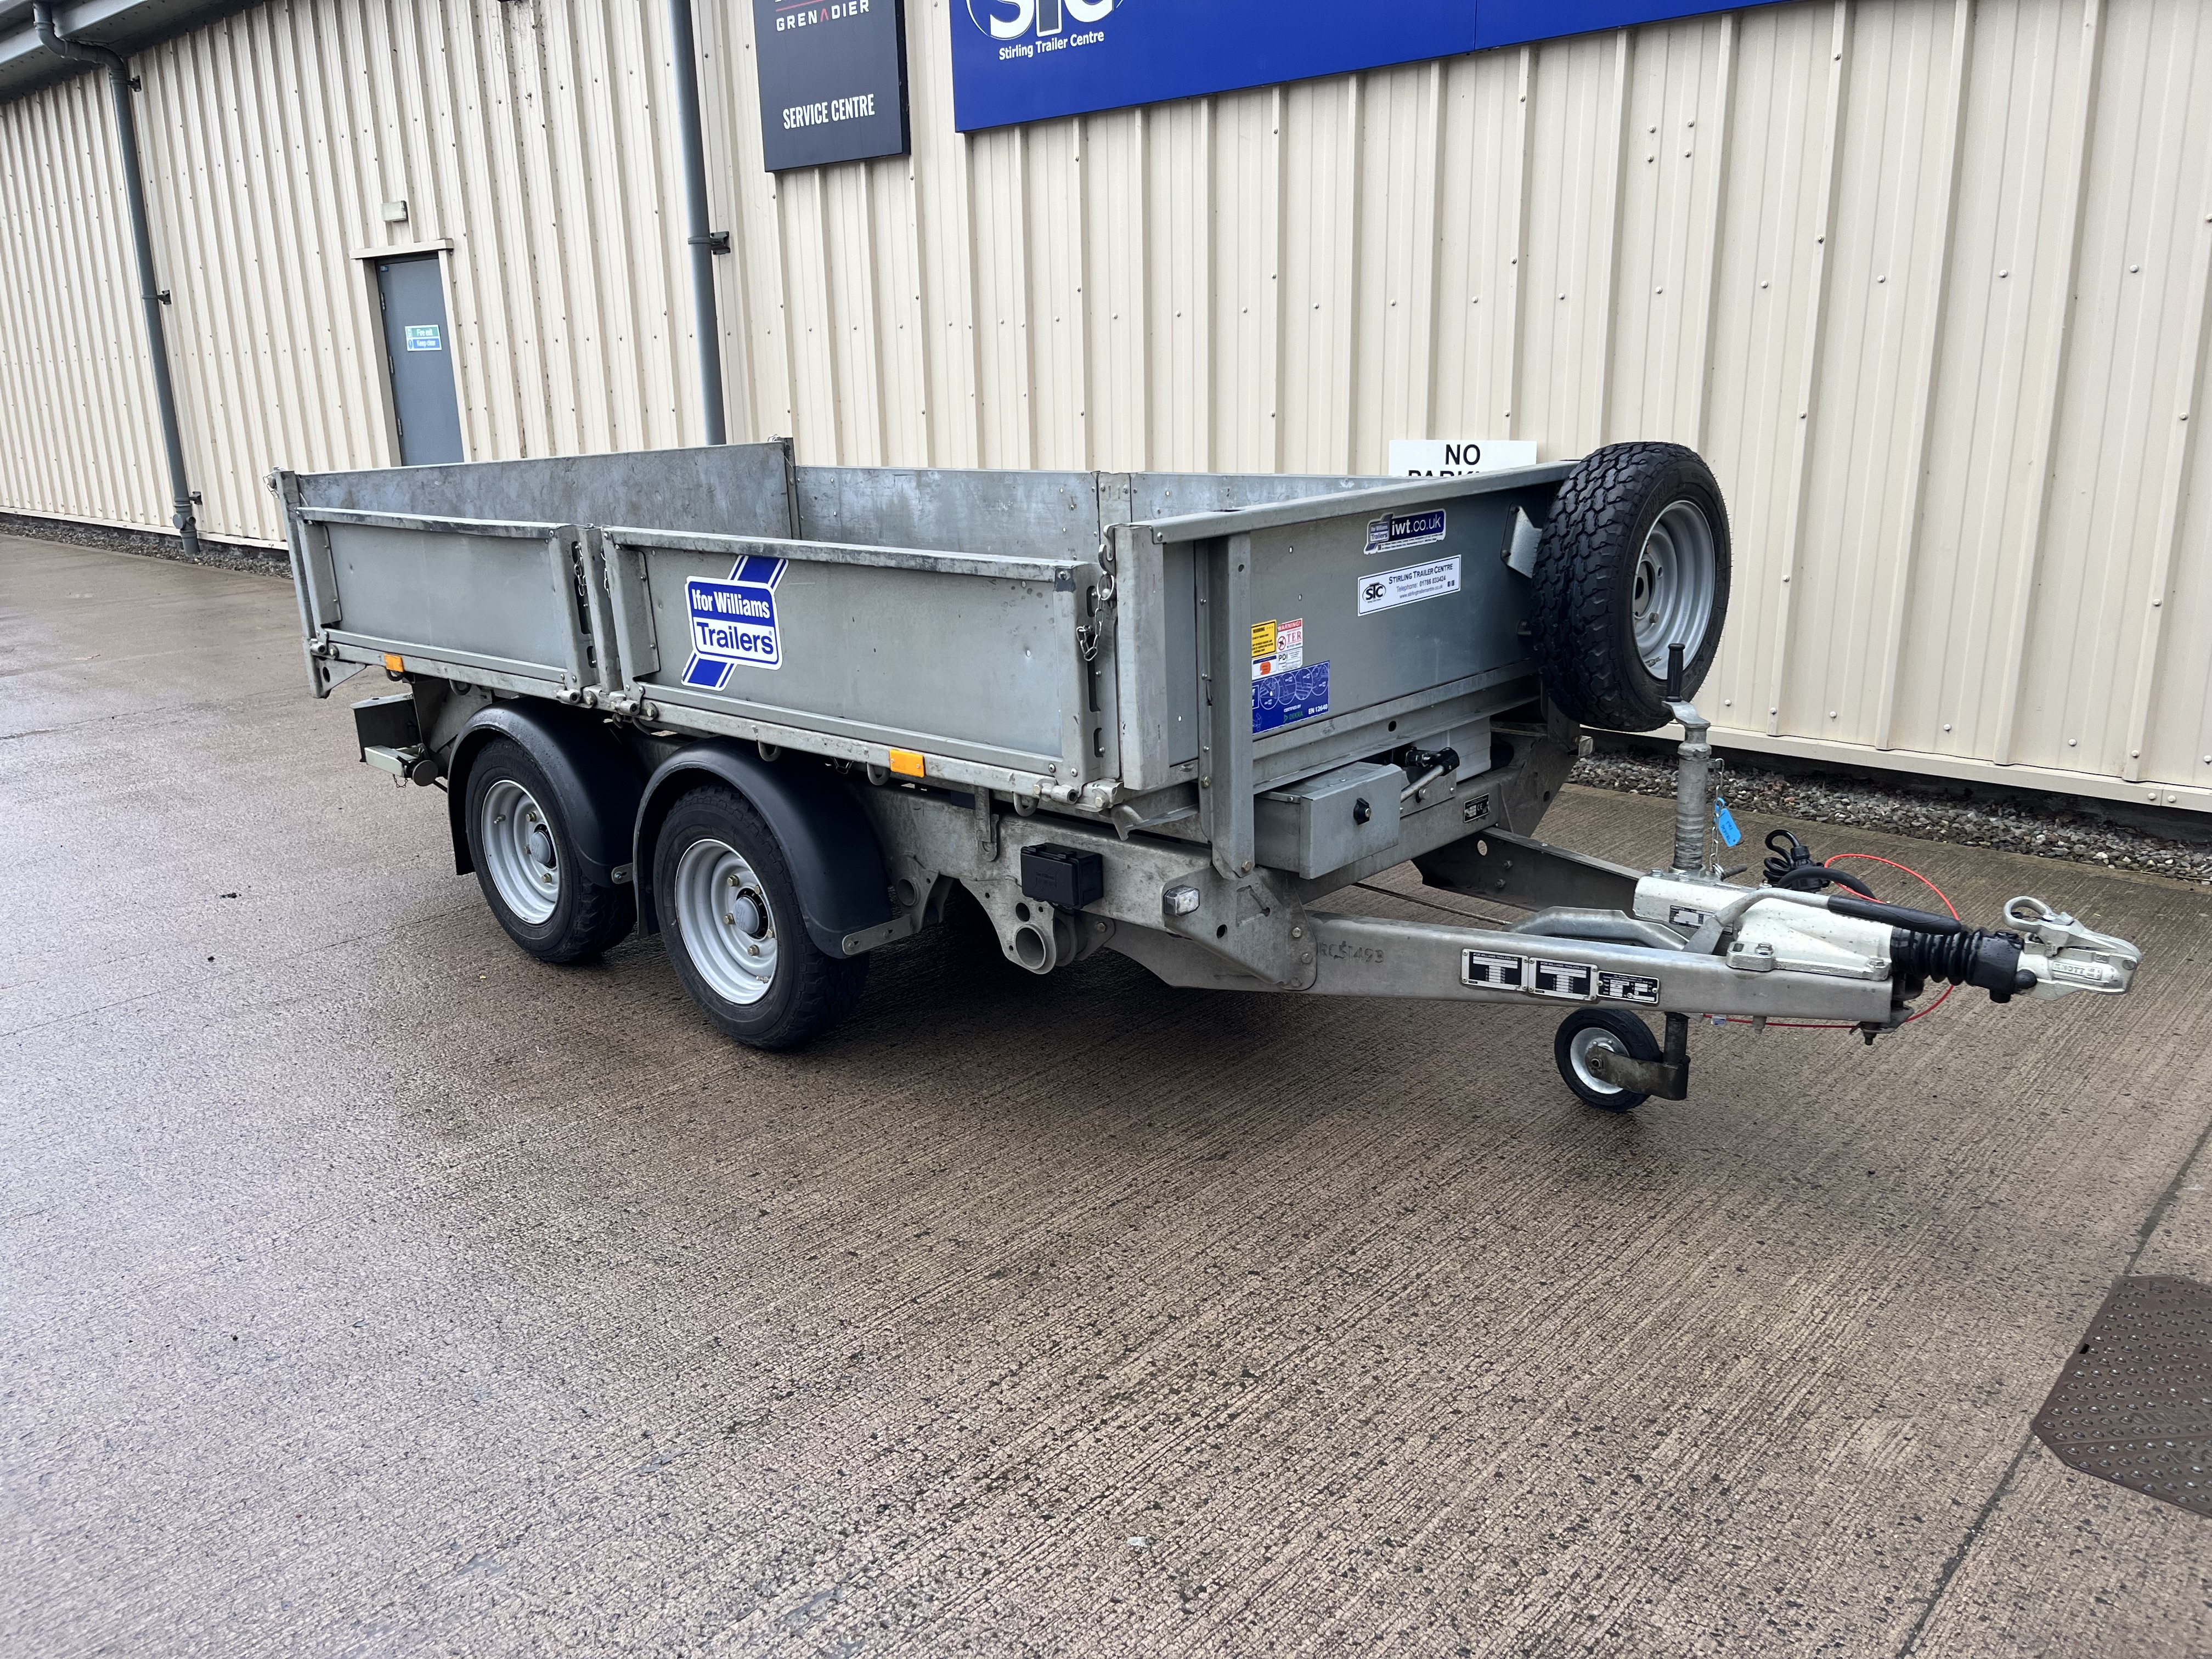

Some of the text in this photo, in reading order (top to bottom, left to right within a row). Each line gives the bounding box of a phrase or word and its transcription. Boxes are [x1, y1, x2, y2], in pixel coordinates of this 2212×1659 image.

[776, 0, 870, 31] GRENADIER
[999, 31, 1104, 60] Stirling Trailer Centre
[782, 94, 875, 130] SERVICE CENTRE
[416, 340, 426, 348] Keep
[1445, 444, 1480, 465] NO
[1392, 514, 1441, 535] iwt.co.uk
[1389, 563, 1453, 584] STIRLING TRAILER CENTRE
[1365, 582, 1383, 601] STC
[1396, 583, 1418, 592] Telephone:
[691, 589, 770, 618] Ifor Williams
[1278, 620, 1301, 631] WARNING!
[696, 622, 774, 654] Trailers
[1286, 631, 1302, 643] TER
[1278, 653, 1288, 662] PDI
[1315, 704, 1328, 713] 12640
